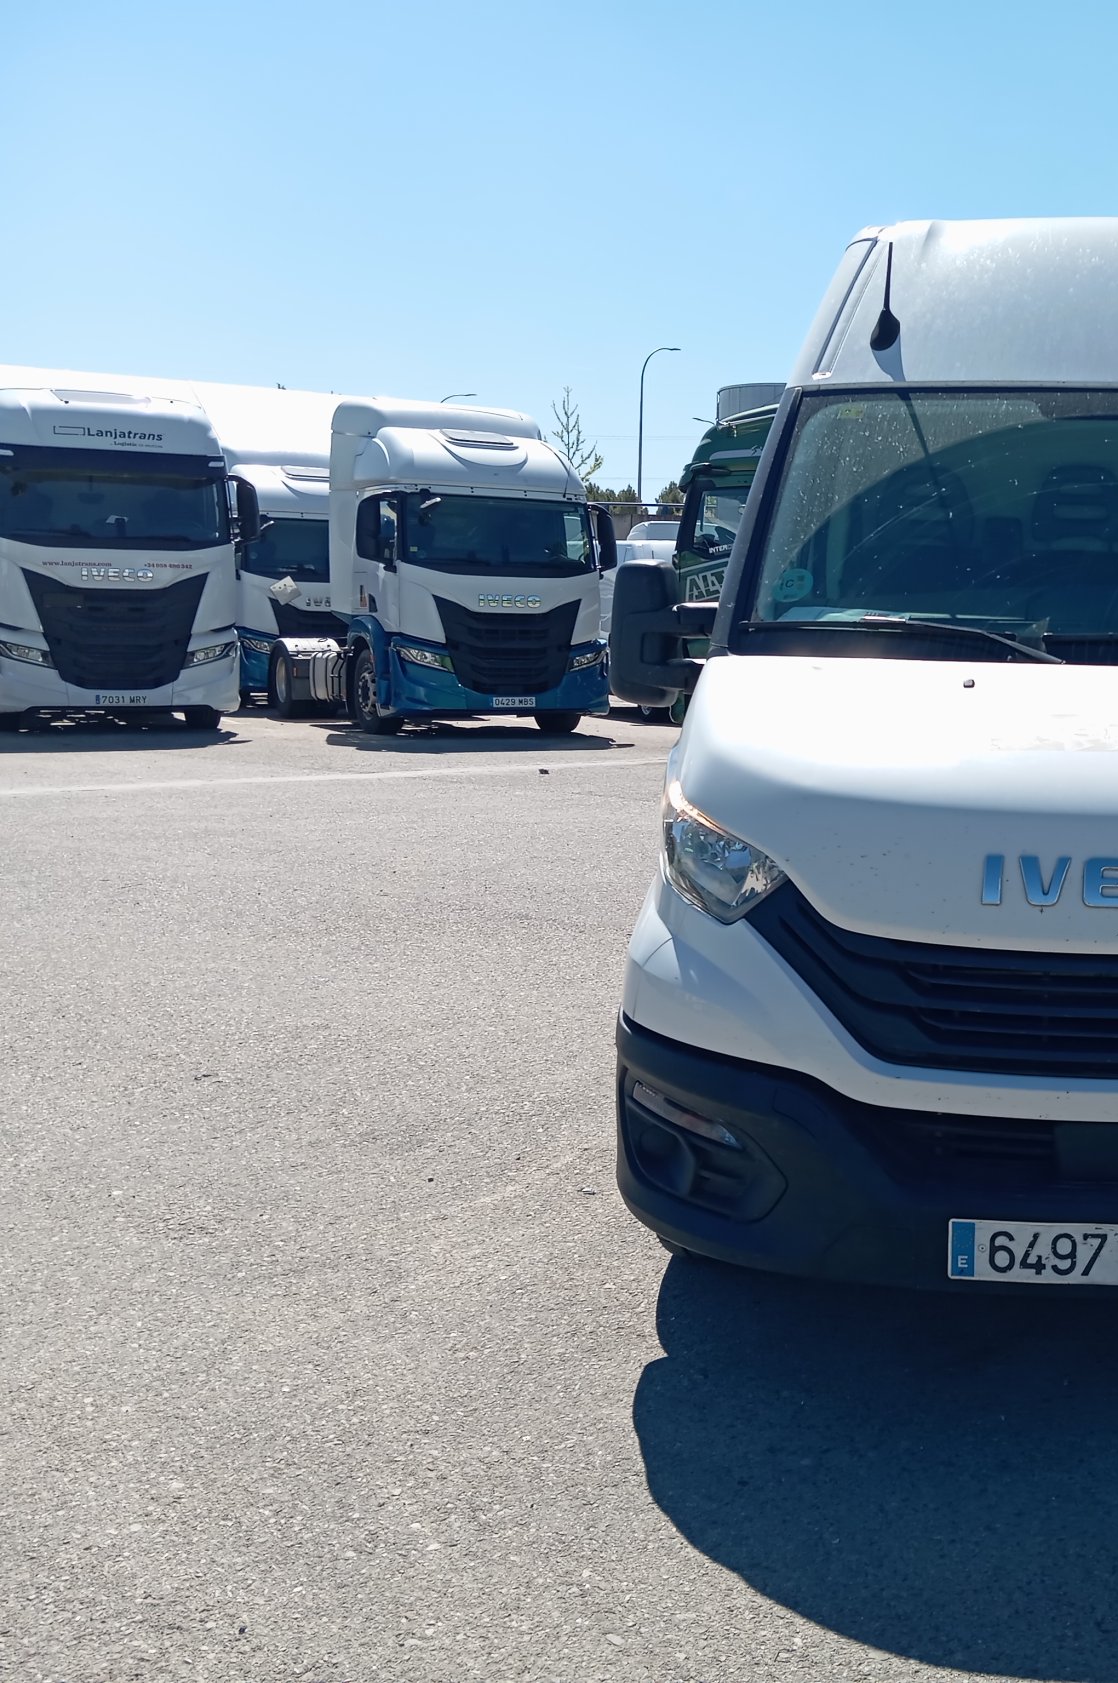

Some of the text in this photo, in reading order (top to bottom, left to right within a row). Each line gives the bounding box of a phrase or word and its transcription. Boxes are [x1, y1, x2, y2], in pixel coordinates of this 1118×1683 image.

[87, 426, 163, 441] Lanjatrans
[81, 567, 154, 582] IVECO
[479, 593, 541, 608] IVECO
[102, 695, 125, 704] 7031
[129, 695, 147, 704] MRY
[494, 698, 535, 706] 0429 MBS
[957, 1255, 968, 1268] E
[988, 1230, 1108, 1277] 6497
